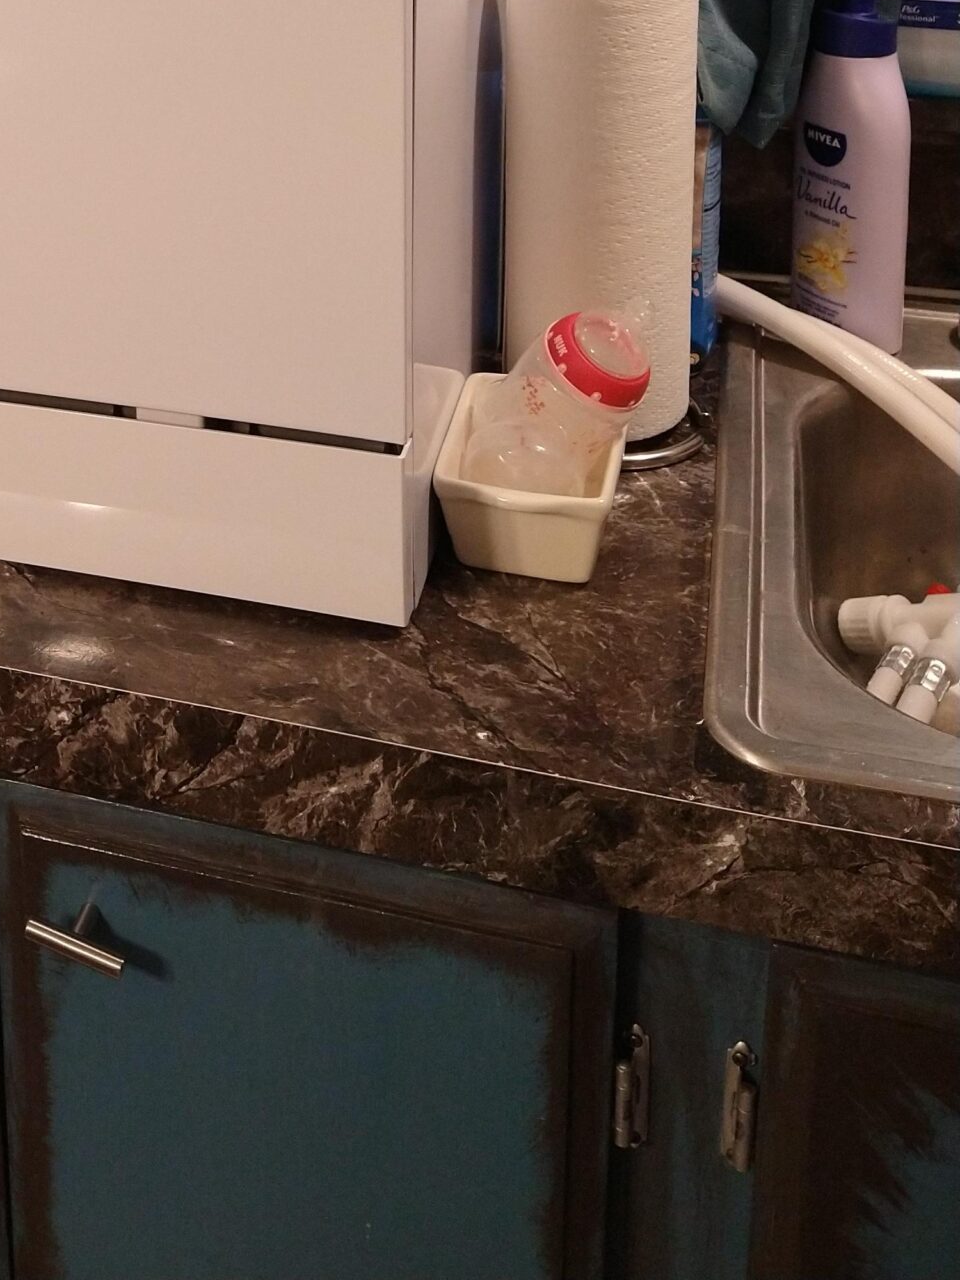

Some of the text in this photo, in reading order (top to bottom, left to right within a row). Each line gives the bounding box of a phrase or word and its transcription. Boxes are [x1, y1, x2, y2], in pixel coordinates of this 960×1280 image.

[808, 128, 840, 148] NIVEA
[797, 175, 857, 220] Vanilla
[553, 334, 568, 357] NUK
